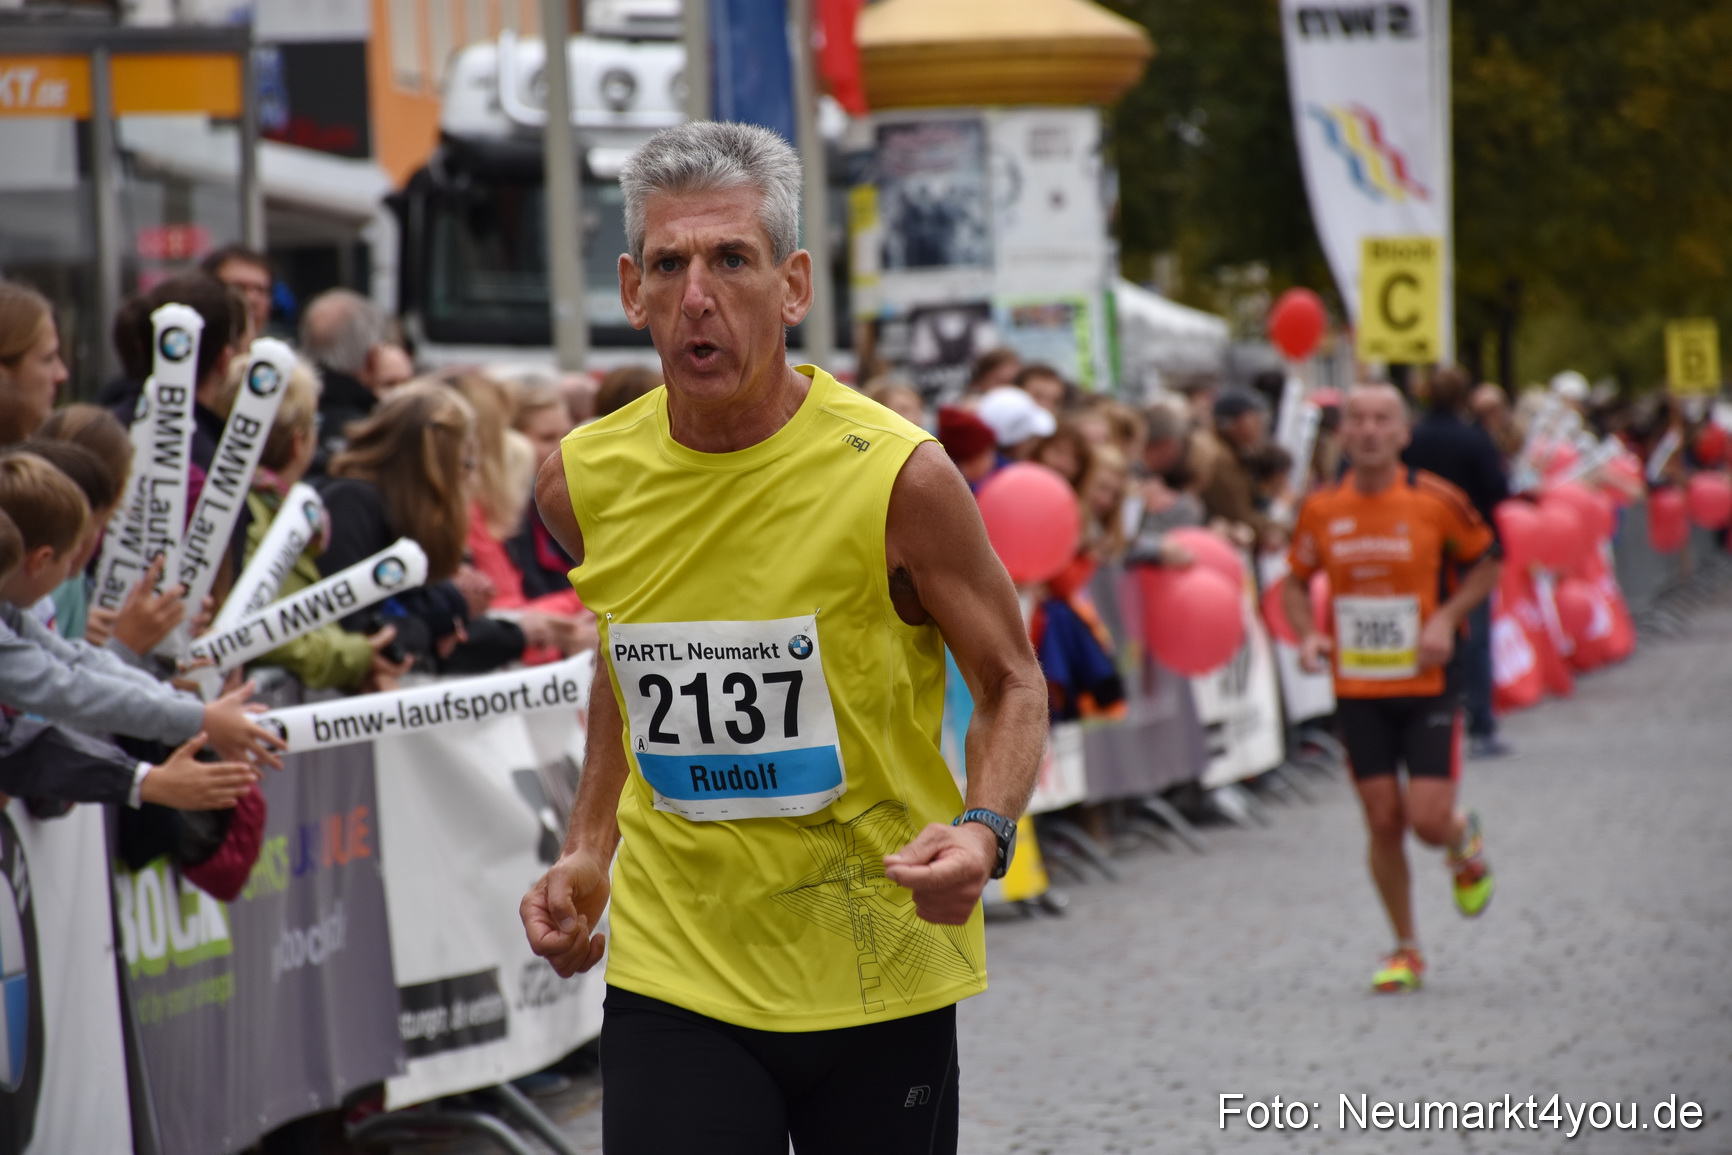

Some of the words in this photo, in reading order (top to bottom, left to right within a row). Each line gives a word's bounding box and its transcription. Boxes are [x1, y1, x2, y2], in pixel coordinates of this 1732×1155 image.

[1379, 271, 1421, 333] C
[153, 384, 186, 471] BMW
[211, 412, 262, 499] BMW
[279, 579, 357, 636] BMW
[615, 643, 683, 661] PARTL
[688, 641, 780, 661] Neumarkt
[312, 674, 579, 743] bmw-laufsport.de
[638, 669, 804, 745] 2137
[690, 763, 778, 792] Rudolf
